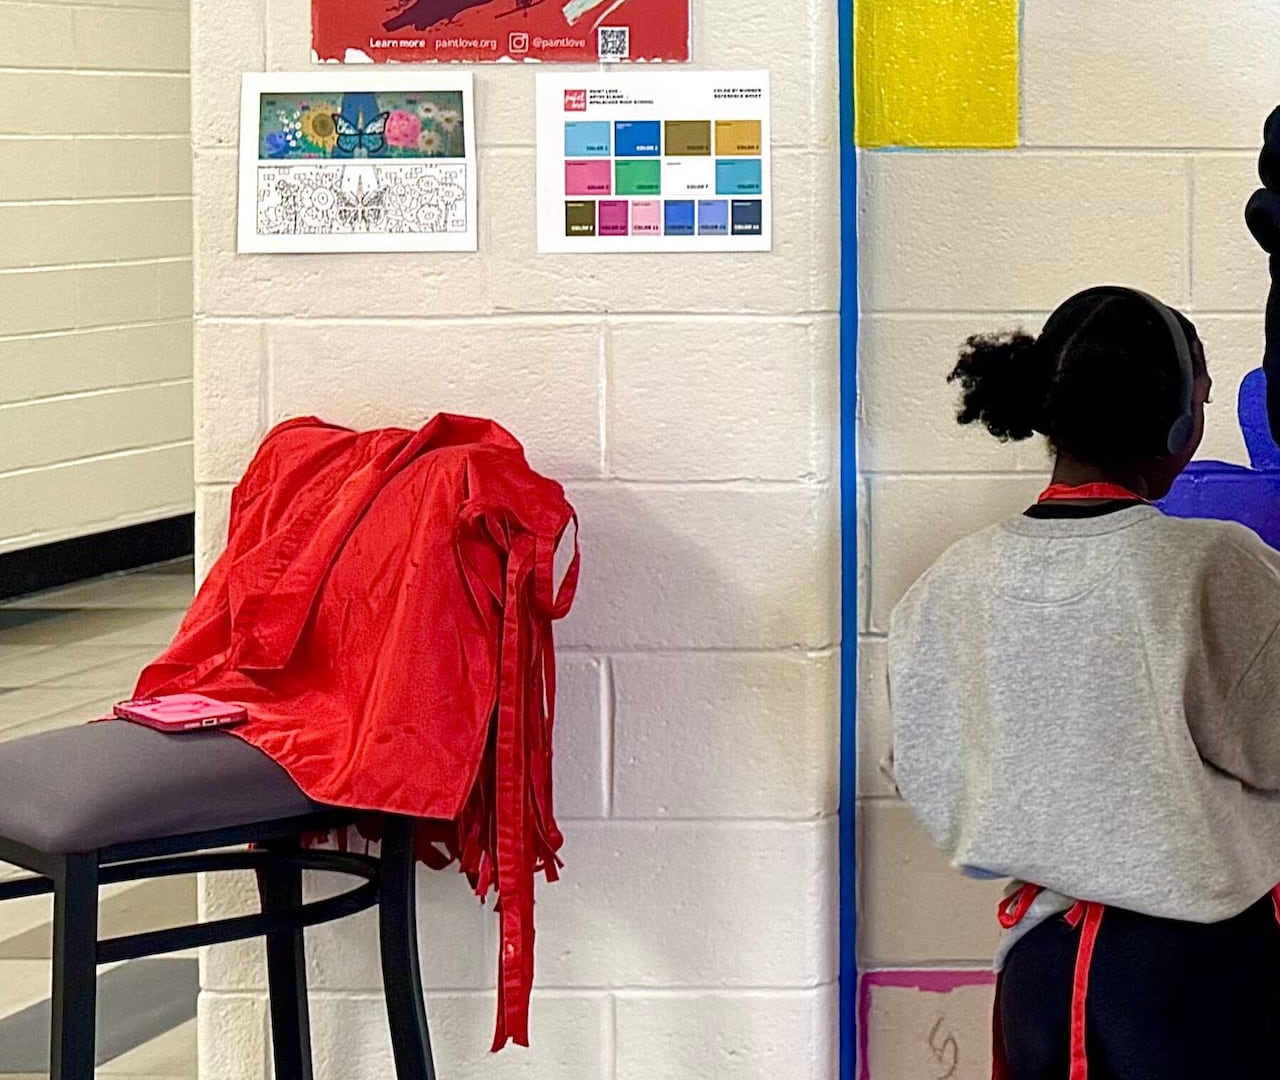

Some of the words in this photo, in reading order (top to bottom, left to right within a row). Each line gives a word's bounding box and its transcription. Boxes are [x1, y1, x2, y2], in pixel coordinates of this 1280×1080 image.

[370, 38, 398, 48] Learn
[400, 39, 425, 48] more
[435, 37, 497, 50] paintlove.org
[533, 37, 586, 49] @paintlove
